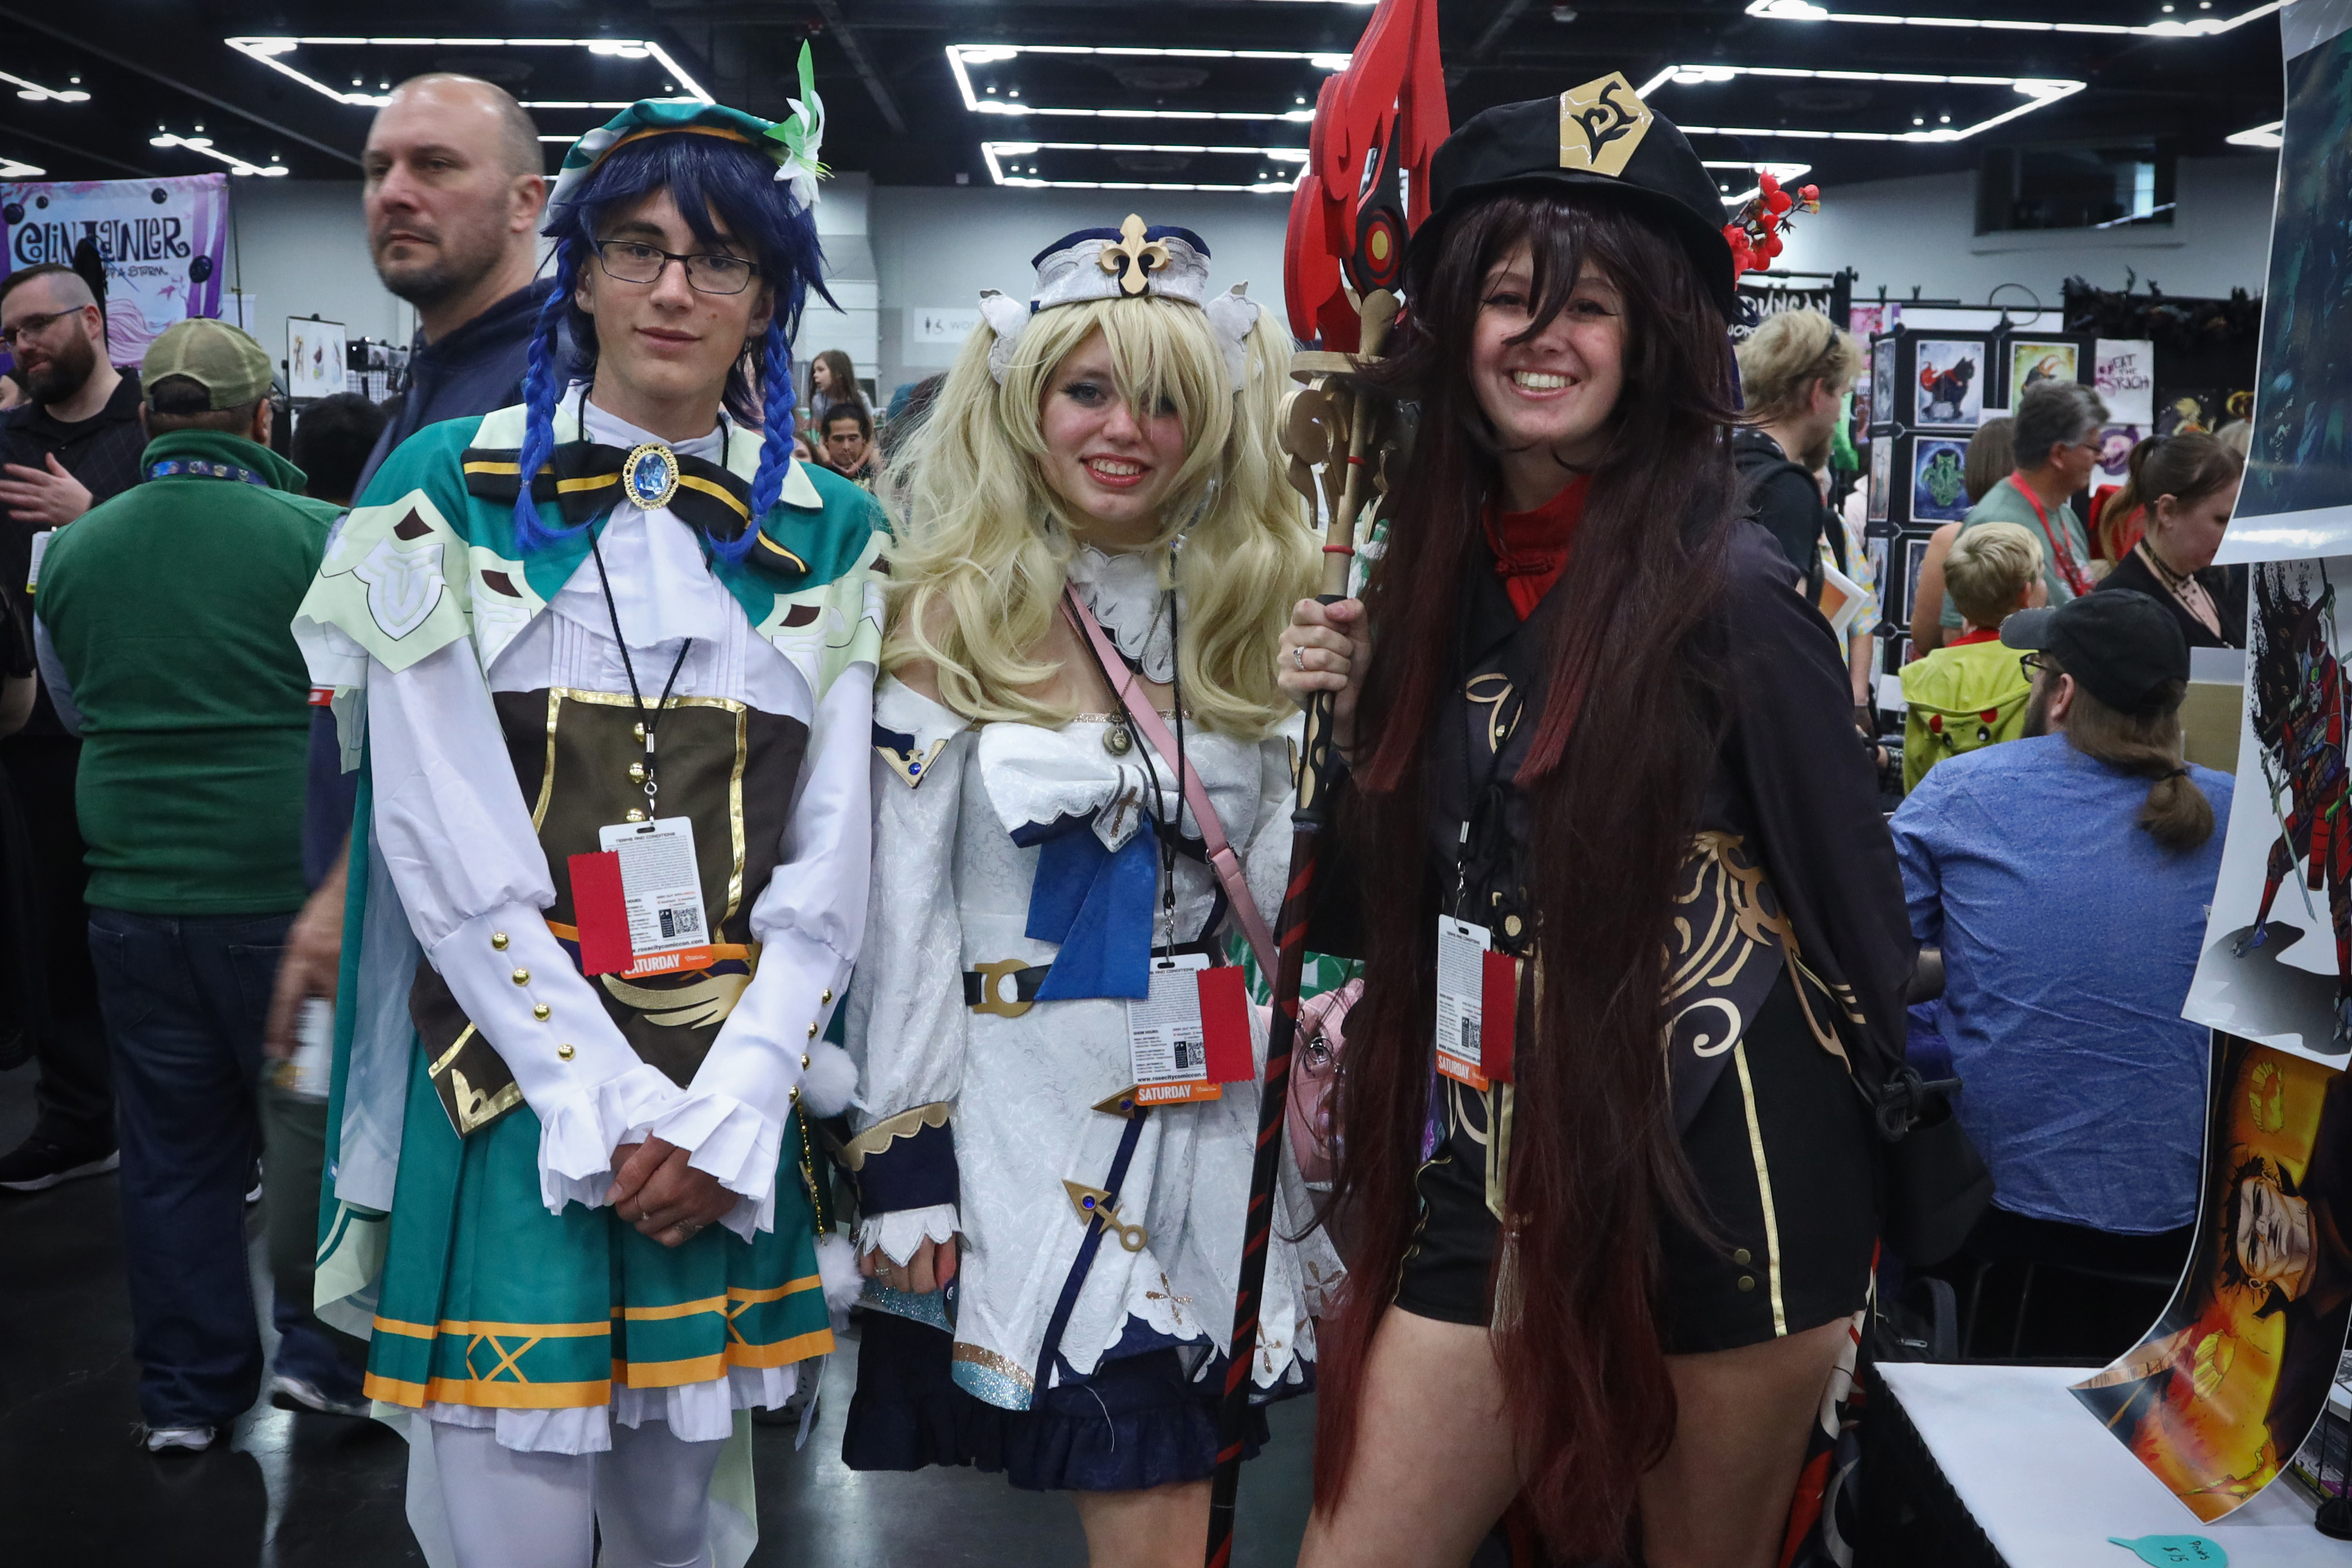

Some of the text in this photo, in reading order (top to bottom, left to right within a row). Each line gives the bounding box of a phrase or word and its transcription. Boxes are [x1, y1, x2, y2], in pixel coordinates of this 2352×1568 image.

[1739, 290, 1831, 318] DUNCAN
[950, 321, 974, 329] WO
[632, 939, 703, 953] w.rosecitycomiccon.com
[1438, 1055, 1470, 1080] SATURDAY
[1138, 1072, 1206, 1082] www.rosecitycomiccon.c
[1138, 1085, 1191, 1102] SATURDAY
